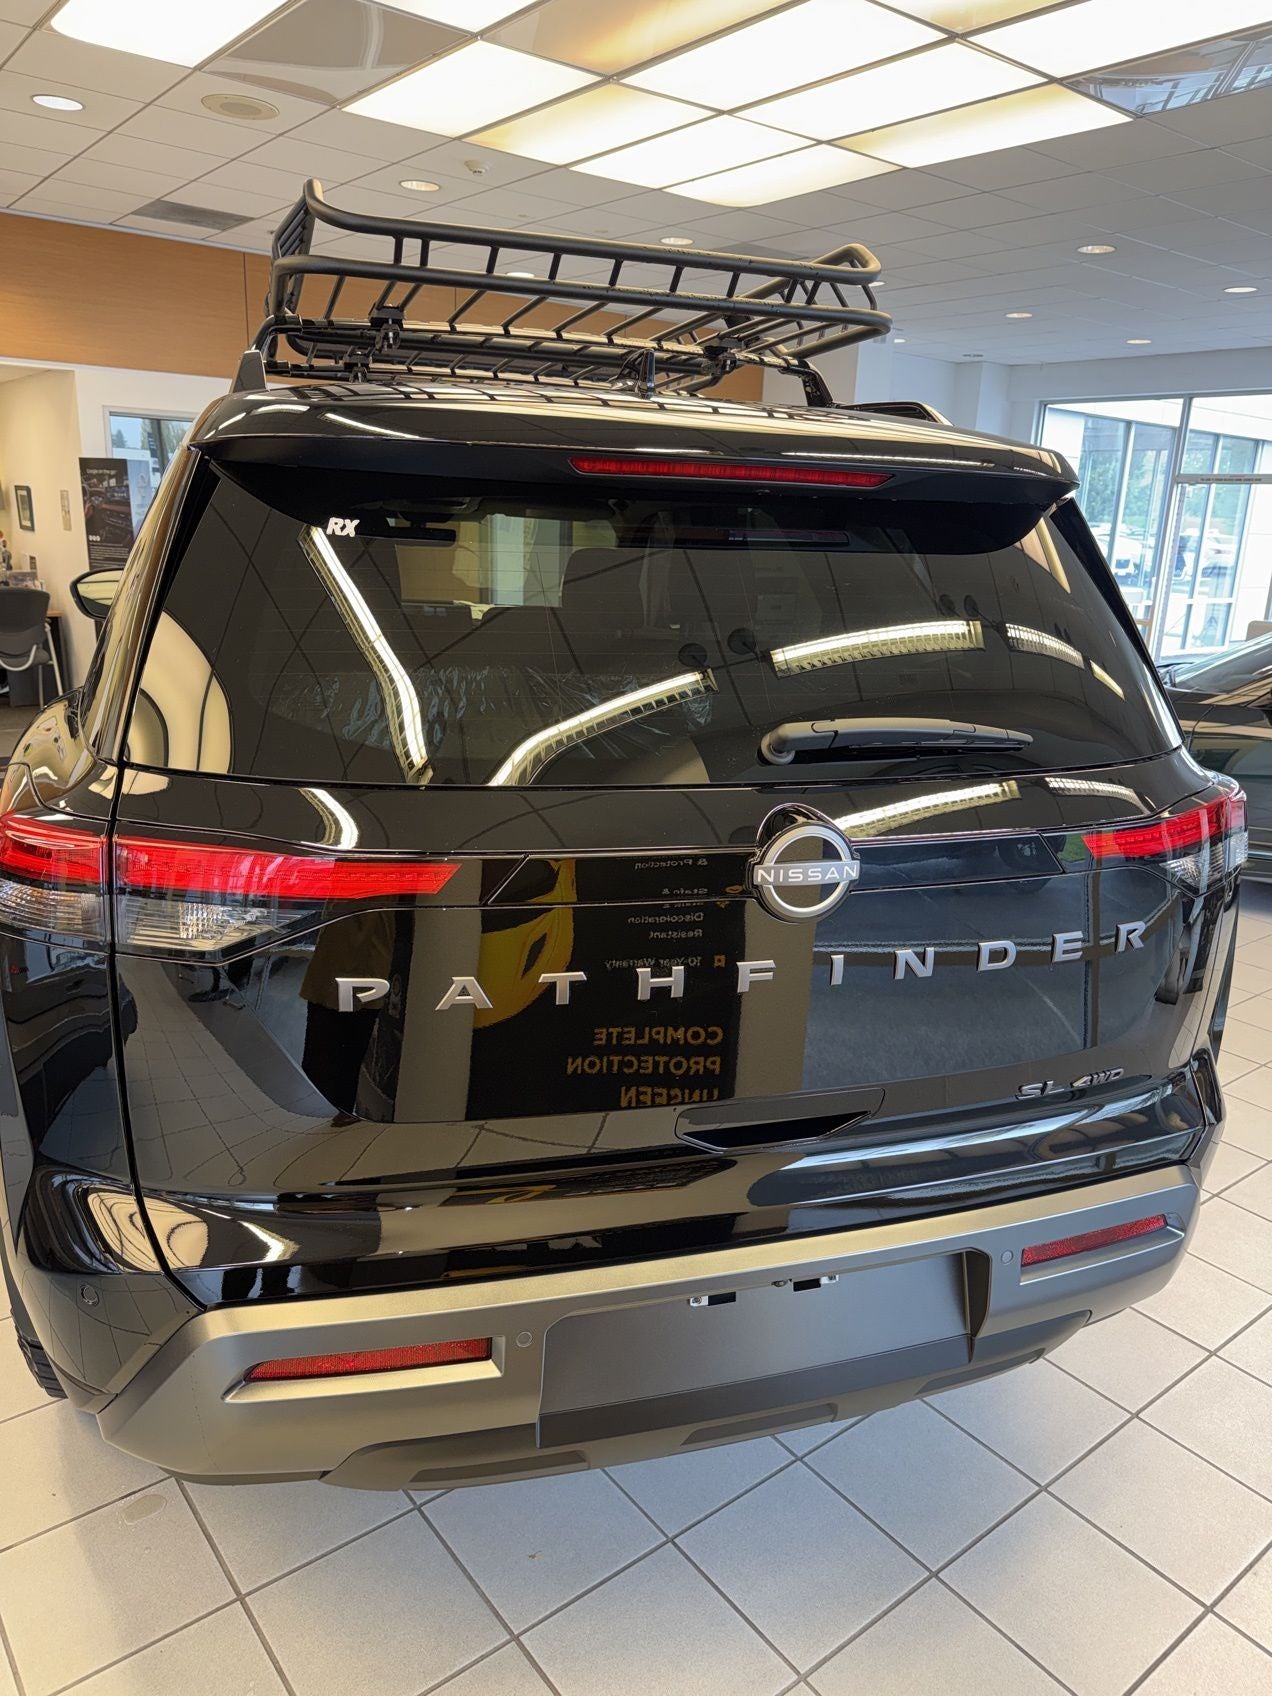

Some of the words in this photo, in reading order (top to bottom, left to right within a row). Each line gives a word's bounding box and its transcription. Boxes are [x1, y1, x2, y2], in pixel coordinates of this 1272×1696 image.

[326, 517, 360, 537] RX
[757, 864, 858, 883] NISSAN
[335, 920, 1146, 1012] PATHFINDER
[1016, 1080, 1065, 1100] SL
[1070, 1067, 1124, 1088] 4WD
